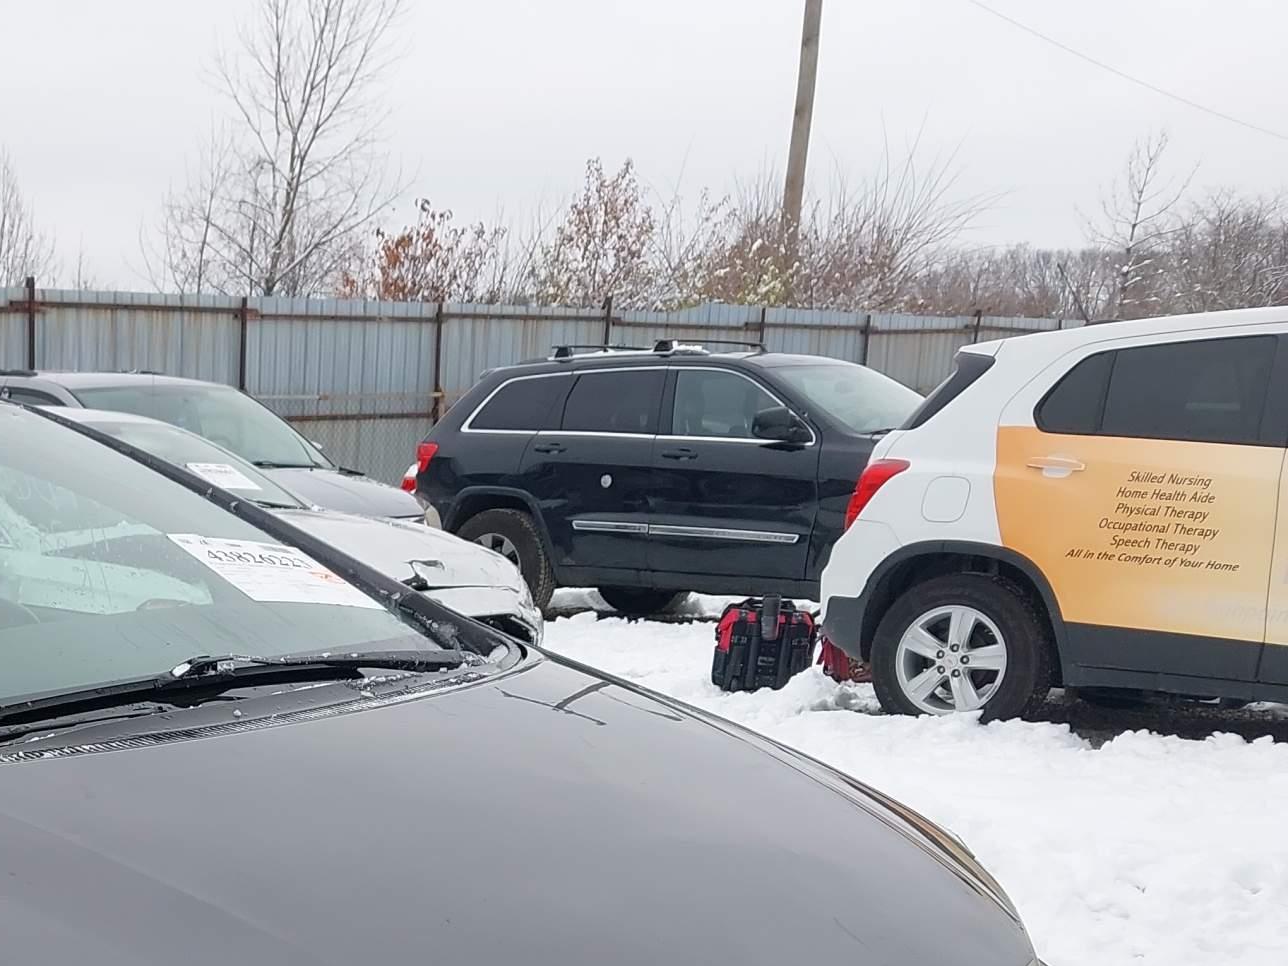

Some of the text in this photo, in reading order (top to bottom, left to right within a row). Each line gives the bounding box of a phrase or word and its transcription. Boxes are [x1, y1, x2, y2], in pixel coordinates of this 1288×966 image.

[1127, 470, 1213, 489] Skilled Nursing
[1115, 487, 1216, 504] Home Health Aide
[1114, 502, 1210, 524] Physical Therapy
[1098, 518, 1220, 540] Occupational Therapy
[1110, 534, 1201, 555] Speech Therapy
[1065, 549, 1241, 572] All in the Comfort of Your Home
